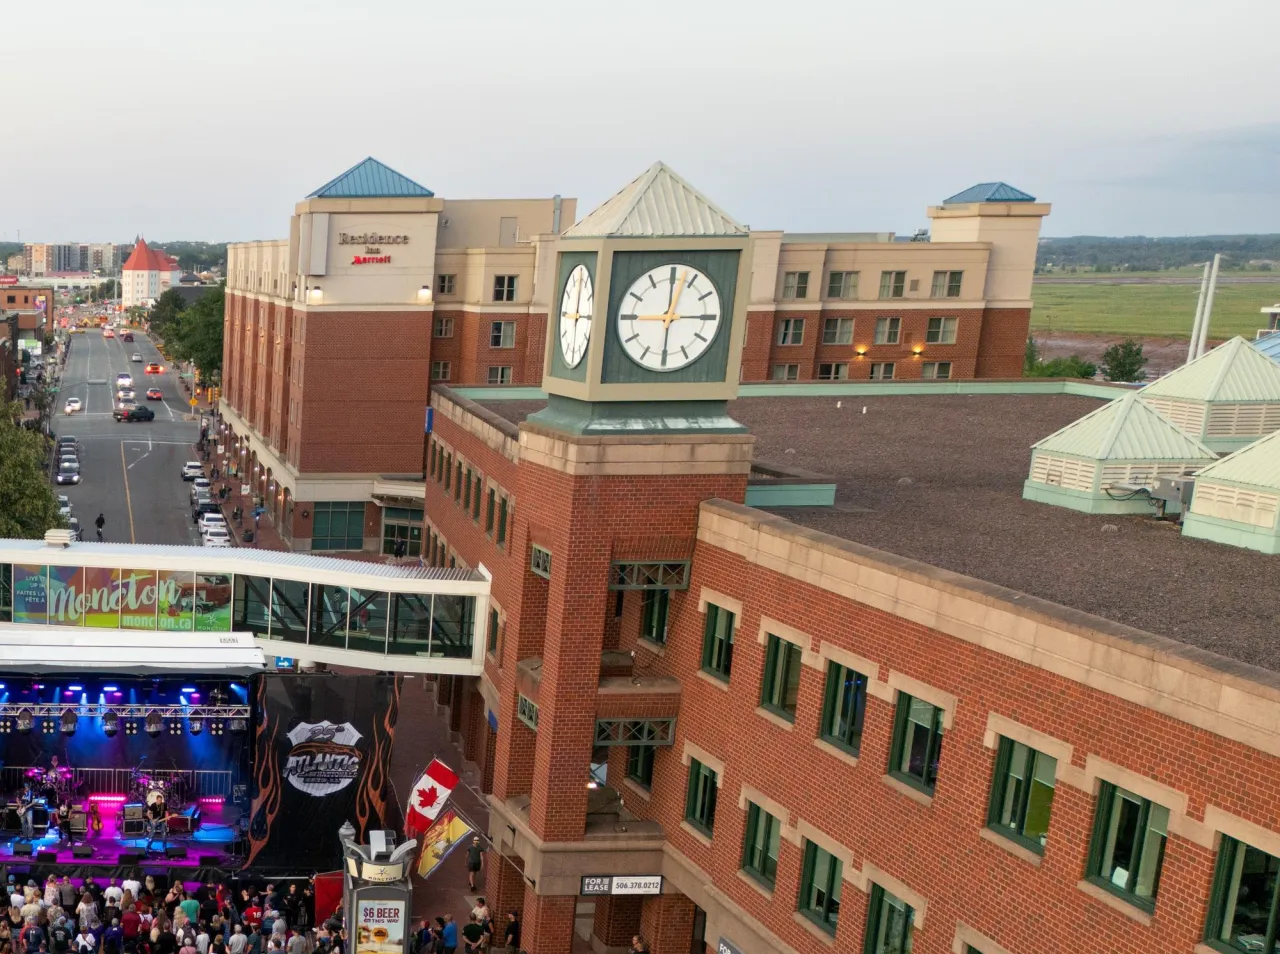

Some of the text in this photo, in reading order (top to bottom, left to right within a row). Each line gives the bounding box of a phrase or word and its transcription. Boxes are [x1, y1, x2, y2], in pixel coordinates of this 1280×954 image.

[338, 232, 410, 245] Residence
[365, 246, 381, 254] Inn
[352, 255, 391, 265] Marriott
[49, 572, 182, 622] Moncton
[123, 614, 192, 629] moncon.ca
[282, 753, 359, 778] ATLANTIC
[363, 907, 400, 918] $6 BEER
